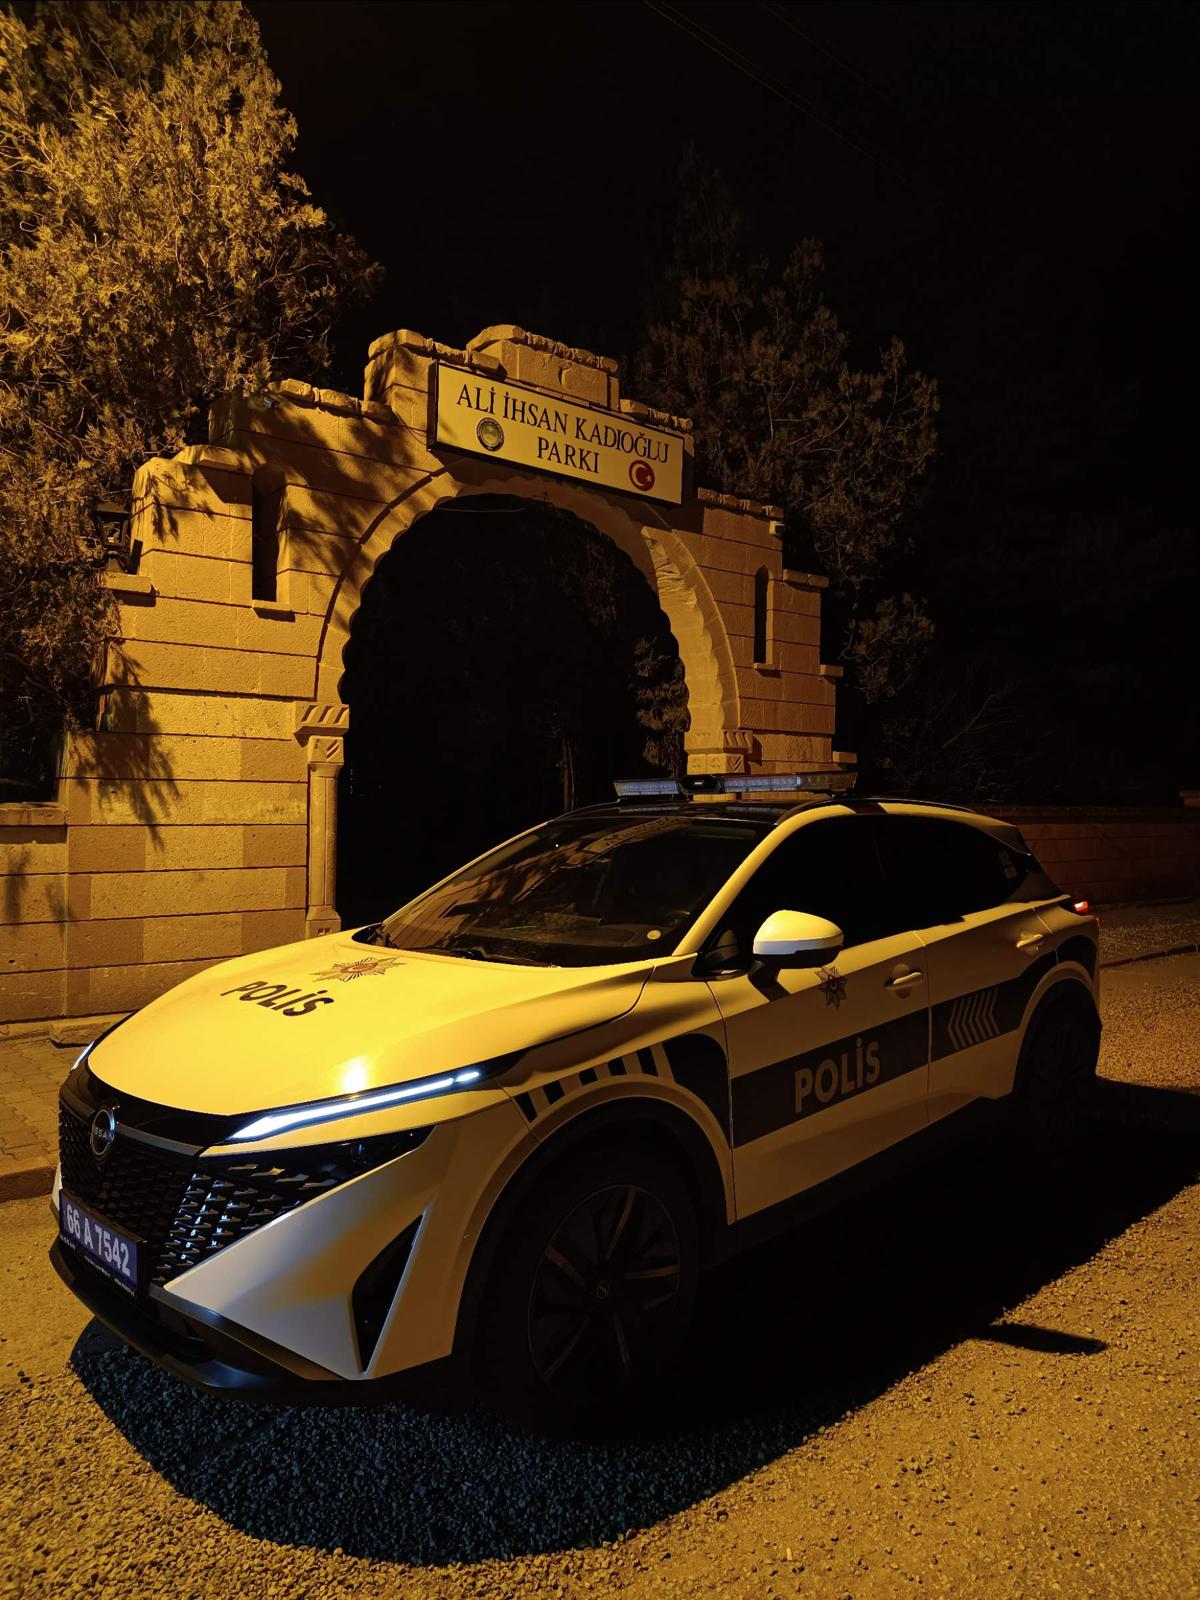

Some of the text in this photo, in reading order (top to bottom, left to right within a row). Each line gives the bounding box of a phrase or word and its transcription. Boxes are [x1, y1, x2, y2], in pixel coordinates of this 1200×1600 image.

[456, 384, 495, 415] ALİ
[502, 391, 569, 435] İHSAN
[575, 417, 670, 463] KADIOĞLU
[537, 436, 600, 473] PARKI
[220, 981, 334, 1016] POLİS
[794, 1038, 880, 1113] POLİS
[66, 1204, 80, 1239] 66
[84, 1217, 94, 1250] A
[95, 1223, 131, 1277] 7542
